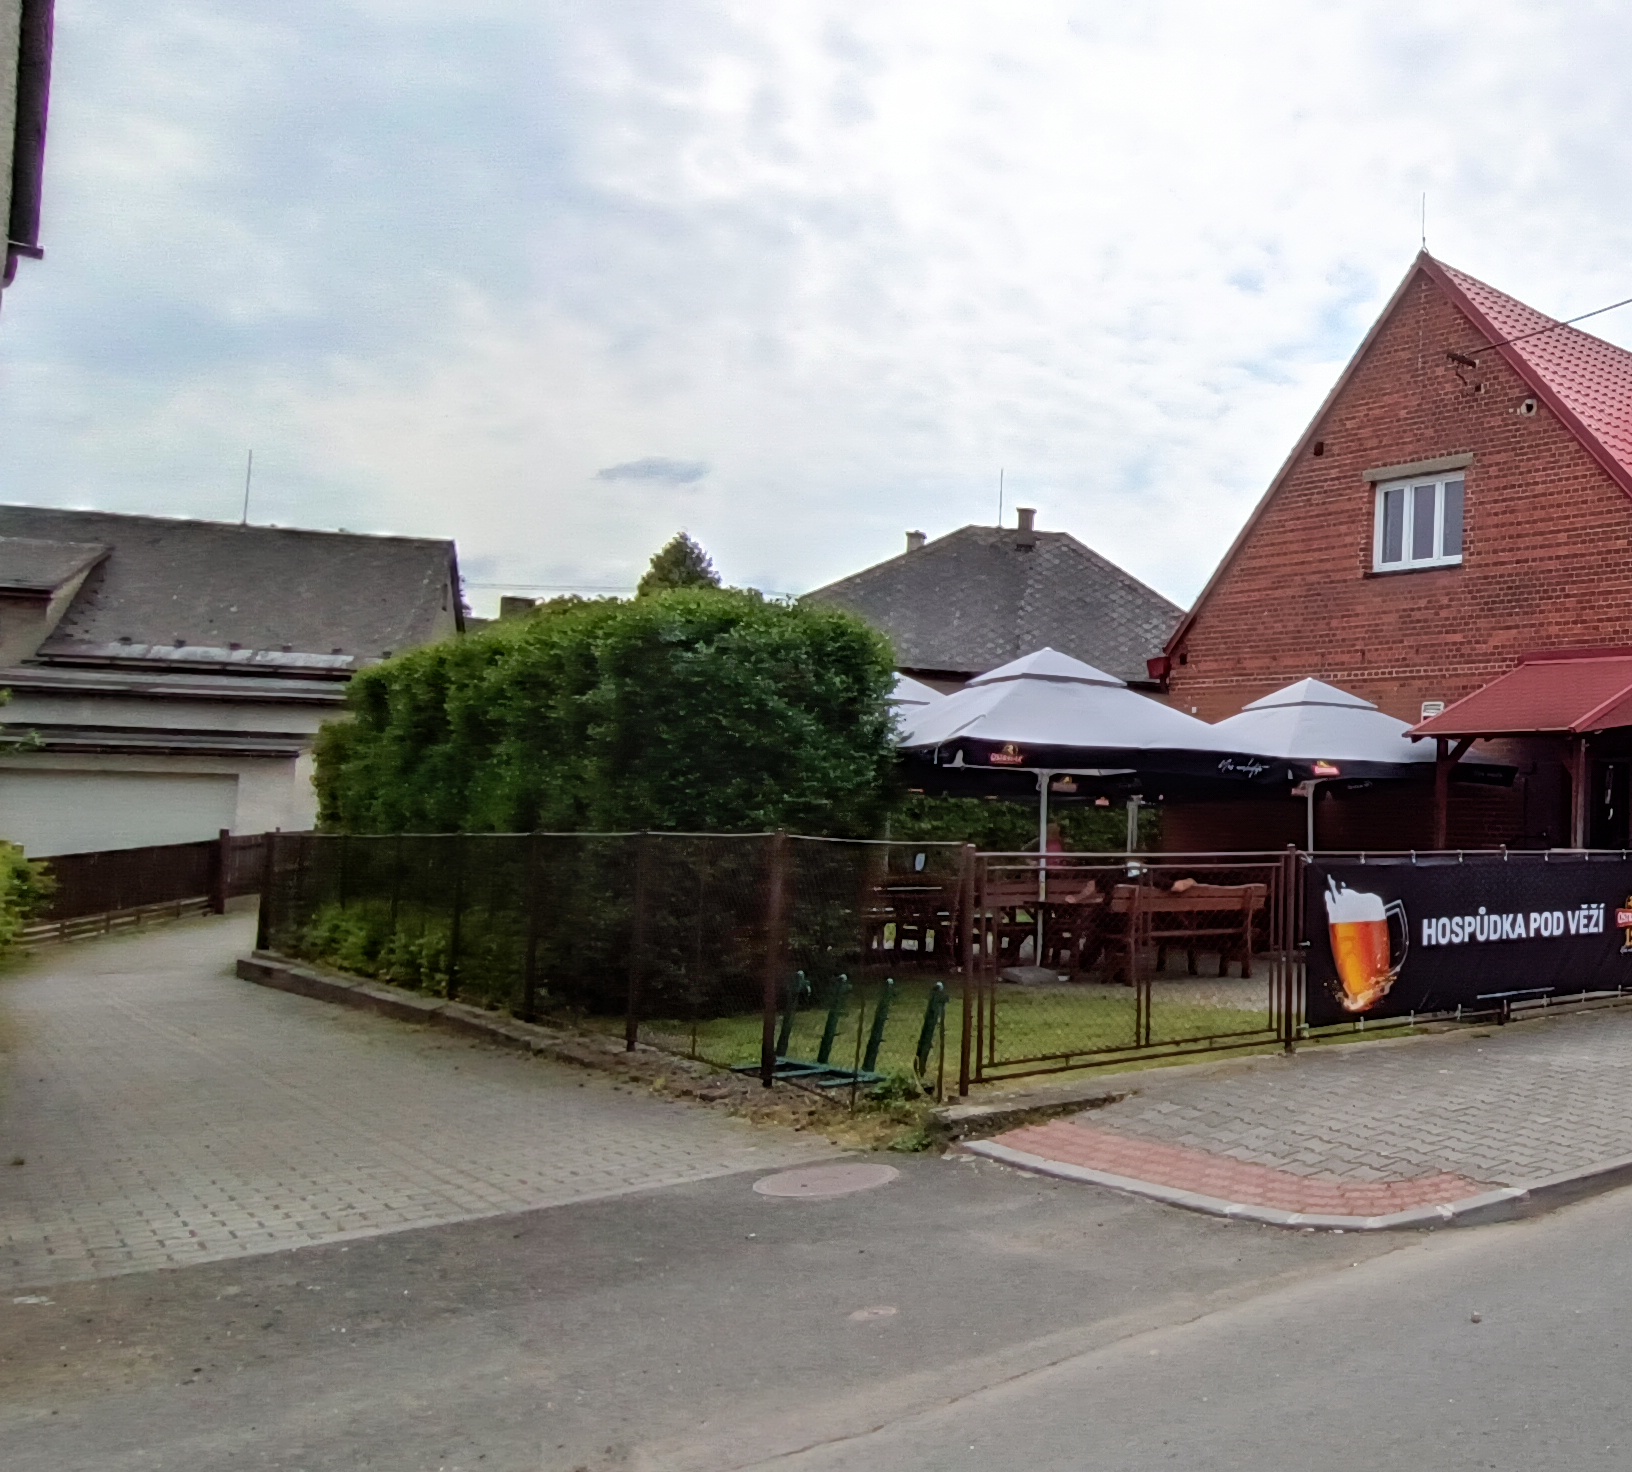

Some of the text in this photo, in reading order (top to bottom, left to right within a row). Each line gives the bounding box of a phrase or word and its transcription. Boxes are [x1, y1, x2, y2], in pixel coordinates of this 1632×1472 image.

[1422, 903, 1605, 946] HOSPŮDKA POD VĚŽÍ
